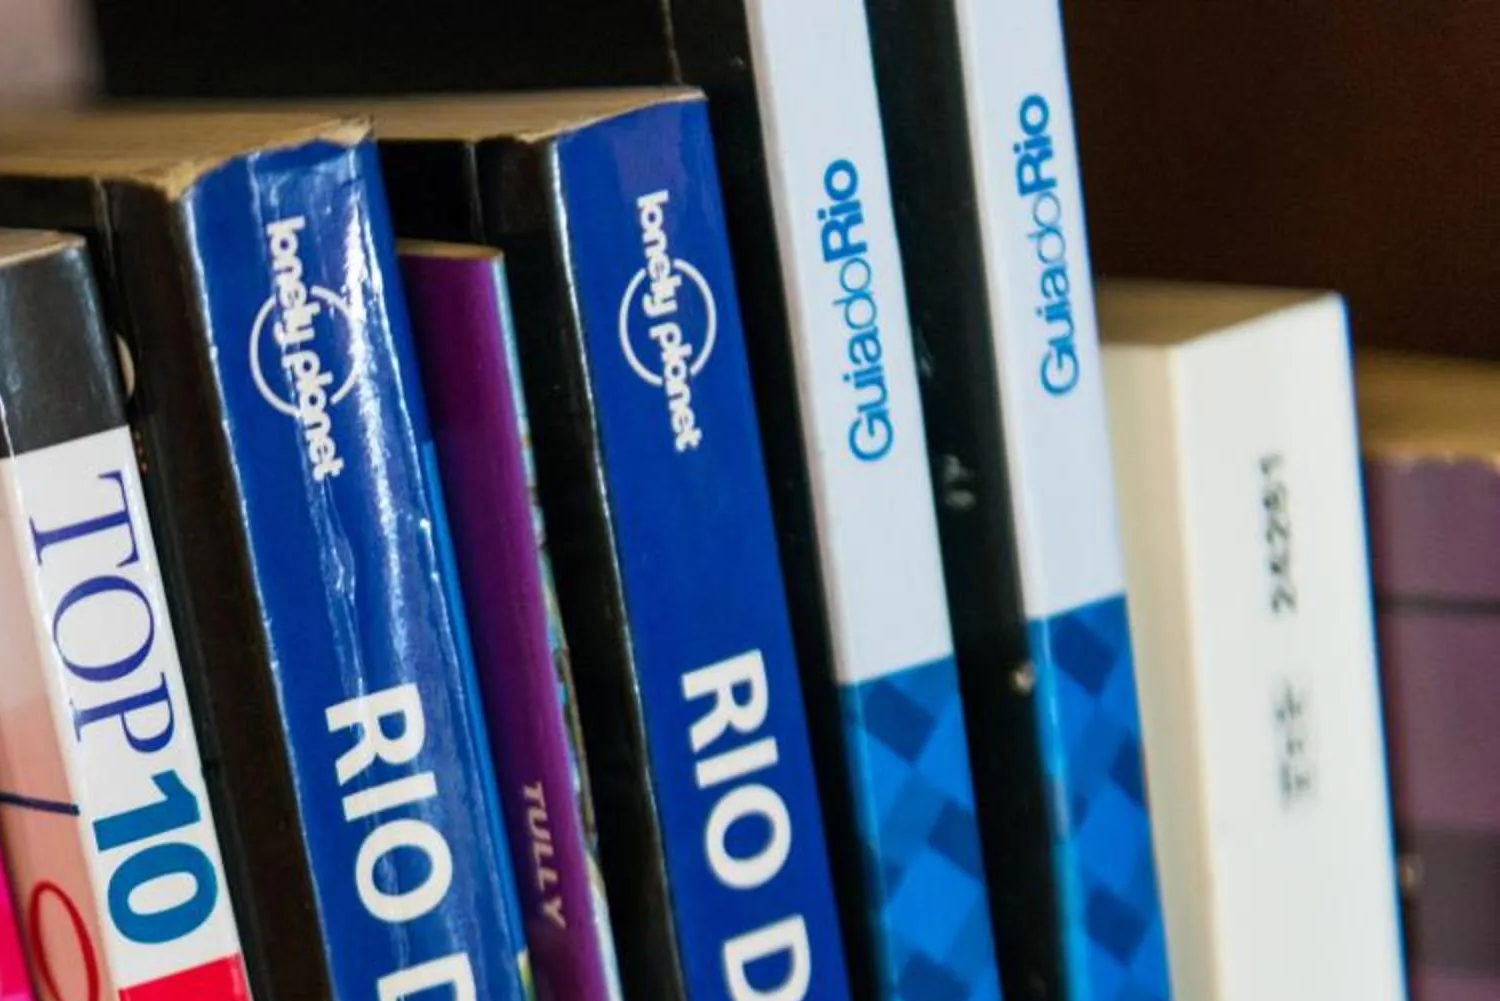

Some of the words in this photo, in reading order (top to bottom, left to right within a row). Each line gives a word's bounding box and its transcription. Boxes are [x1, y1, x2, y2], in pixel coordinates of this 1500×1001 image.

[267, 215, 320, 346] lonely
[637, 190, 682, 317] lonely
[817, 159, 894, 461] GuiadoRio
[1012, 94, 1080, 396] GuiadoRio
[282, 351, 344, 482] planet
[650, 322, 702, 452] planet
[30, 469, 175, 756] TOP
[325, 682, 453, 924] RIO
[519, 780, 566, 928] TULLY
[681, 648, 791, 889] RIO
[92, 769, 219, 945] 10
